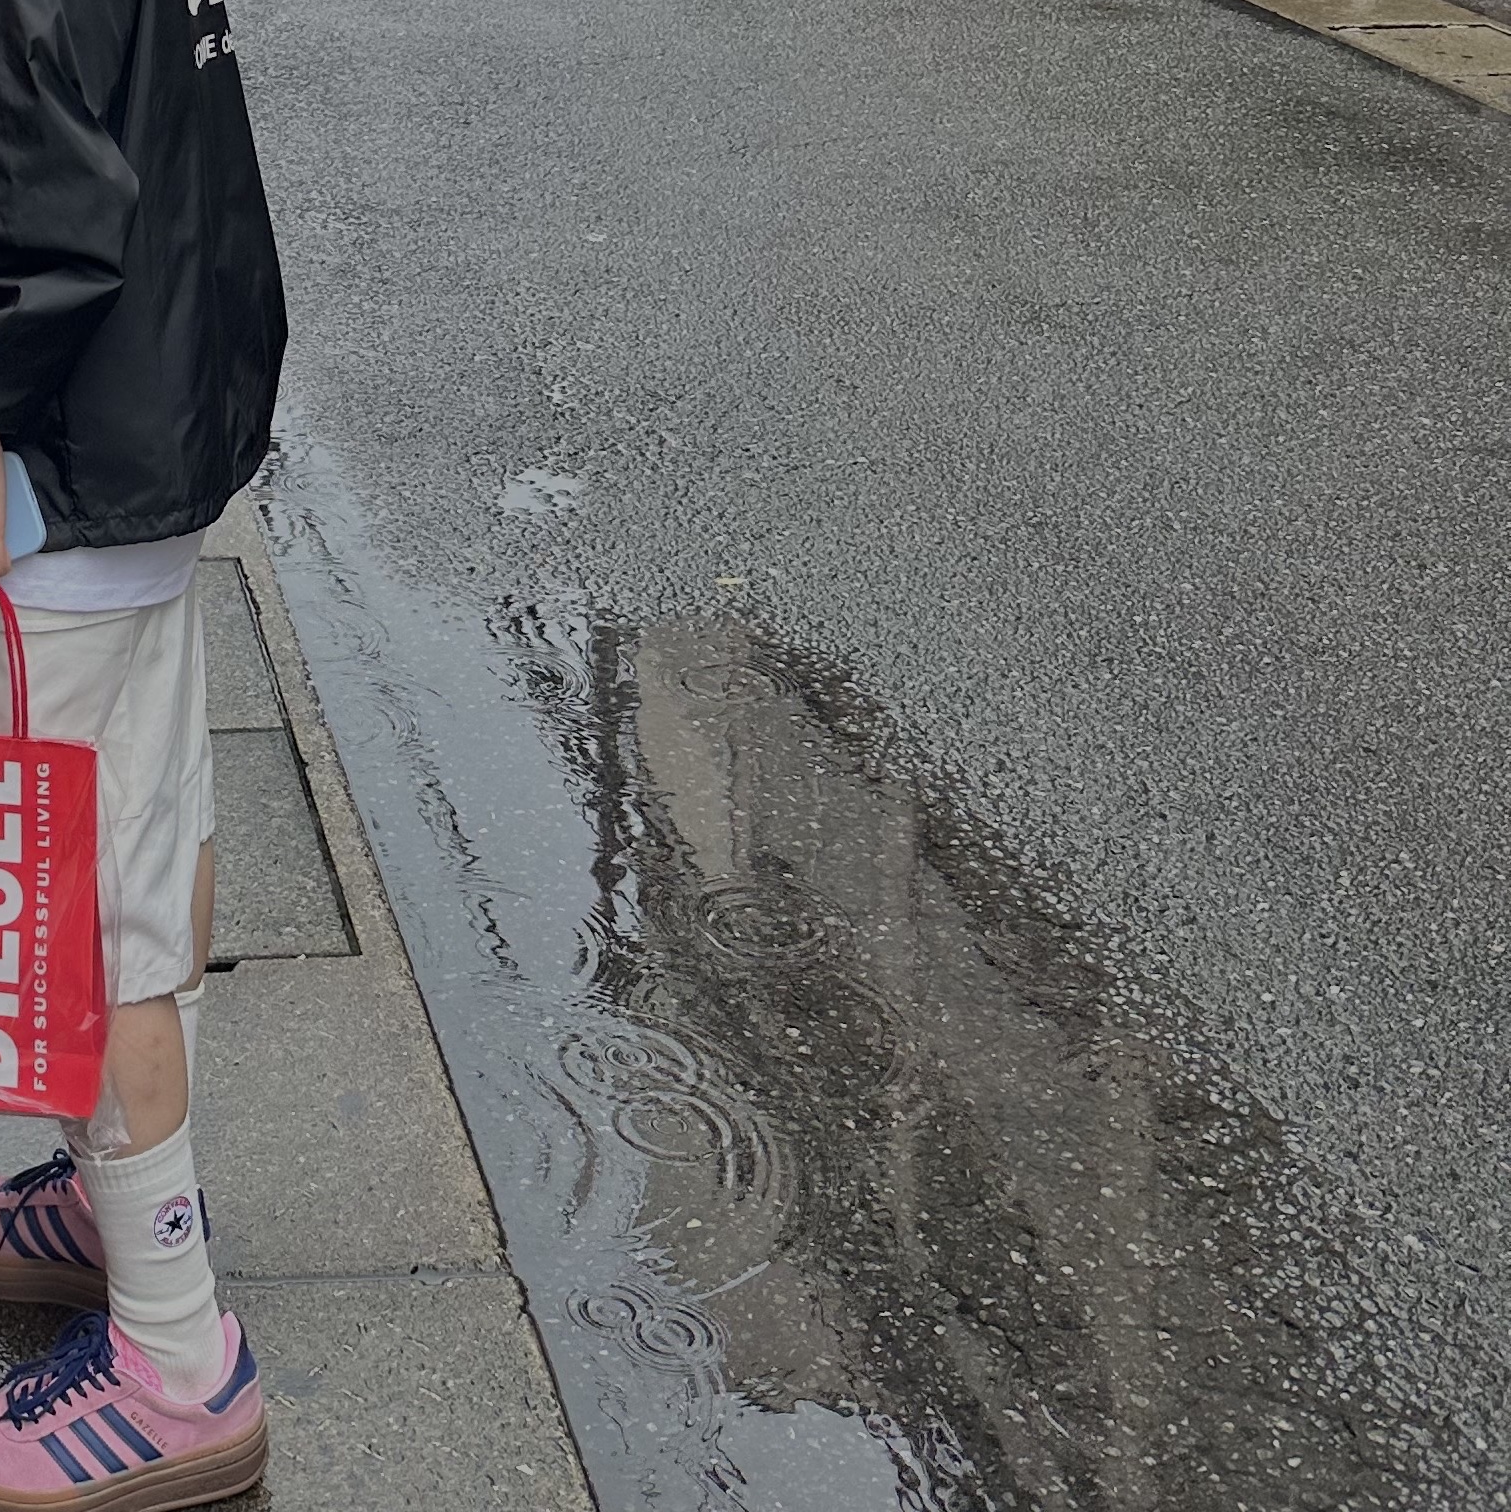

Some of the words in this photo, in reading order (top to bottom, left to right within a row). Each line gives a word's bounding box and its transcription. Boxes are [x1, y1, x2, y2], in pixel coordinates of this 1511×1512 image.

[36, 763, 50, 848] LIVING
[34, 857, 50, 1030] SUCCESSFUL
[33, 1039, 48, 1091] FOR
[130, 1411, 168, 1450] GAZELLE
